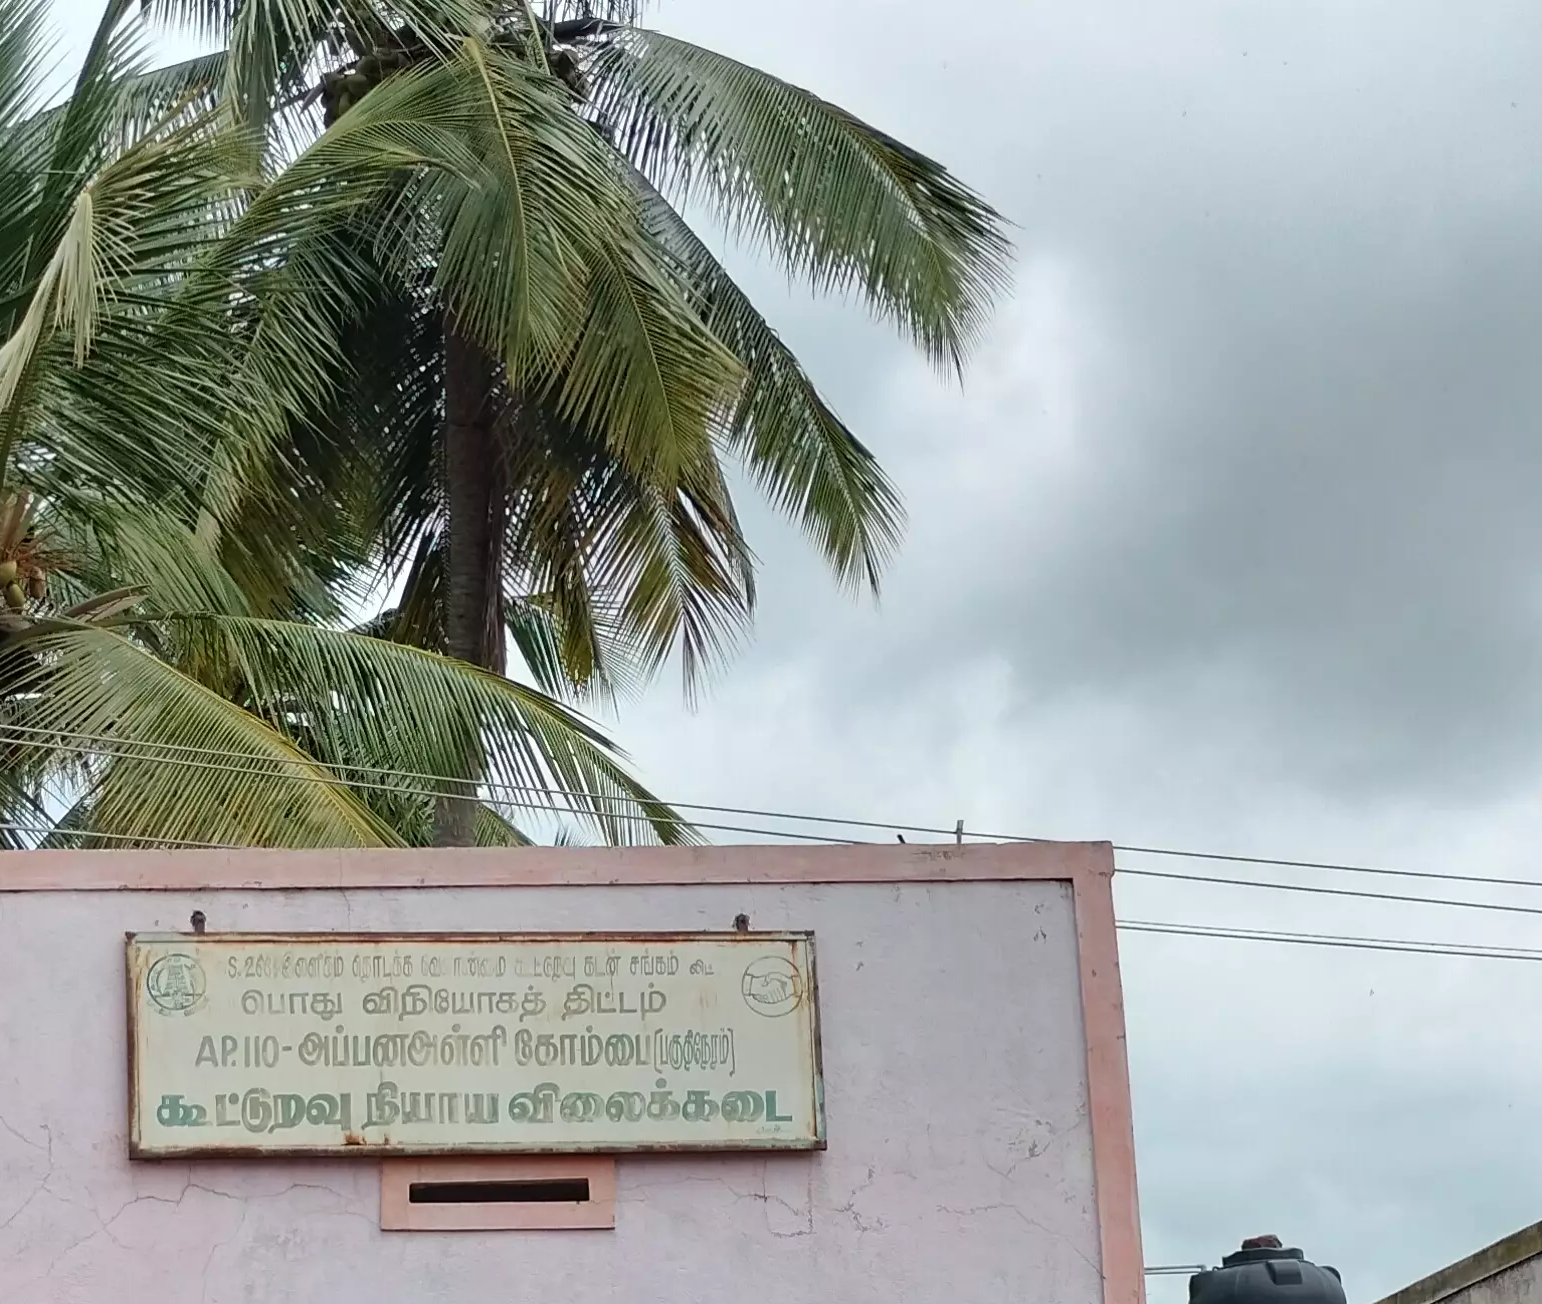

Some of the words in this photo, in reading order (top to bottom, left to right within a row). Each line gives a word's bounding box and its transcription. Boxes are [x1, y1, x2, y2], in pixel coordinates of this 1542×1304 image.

[241, 988, 343, 1021] பொது
[362, 983, 547, 1022] விநியோகத்
[561, 981, 667, 1021] திட்டம்
[156, 1087, 353, 1134] கூட்டுறவு
[361, 1080, 500, 1131] நியாய
[508, 1077, 793, 1124] விலைக்கடை
